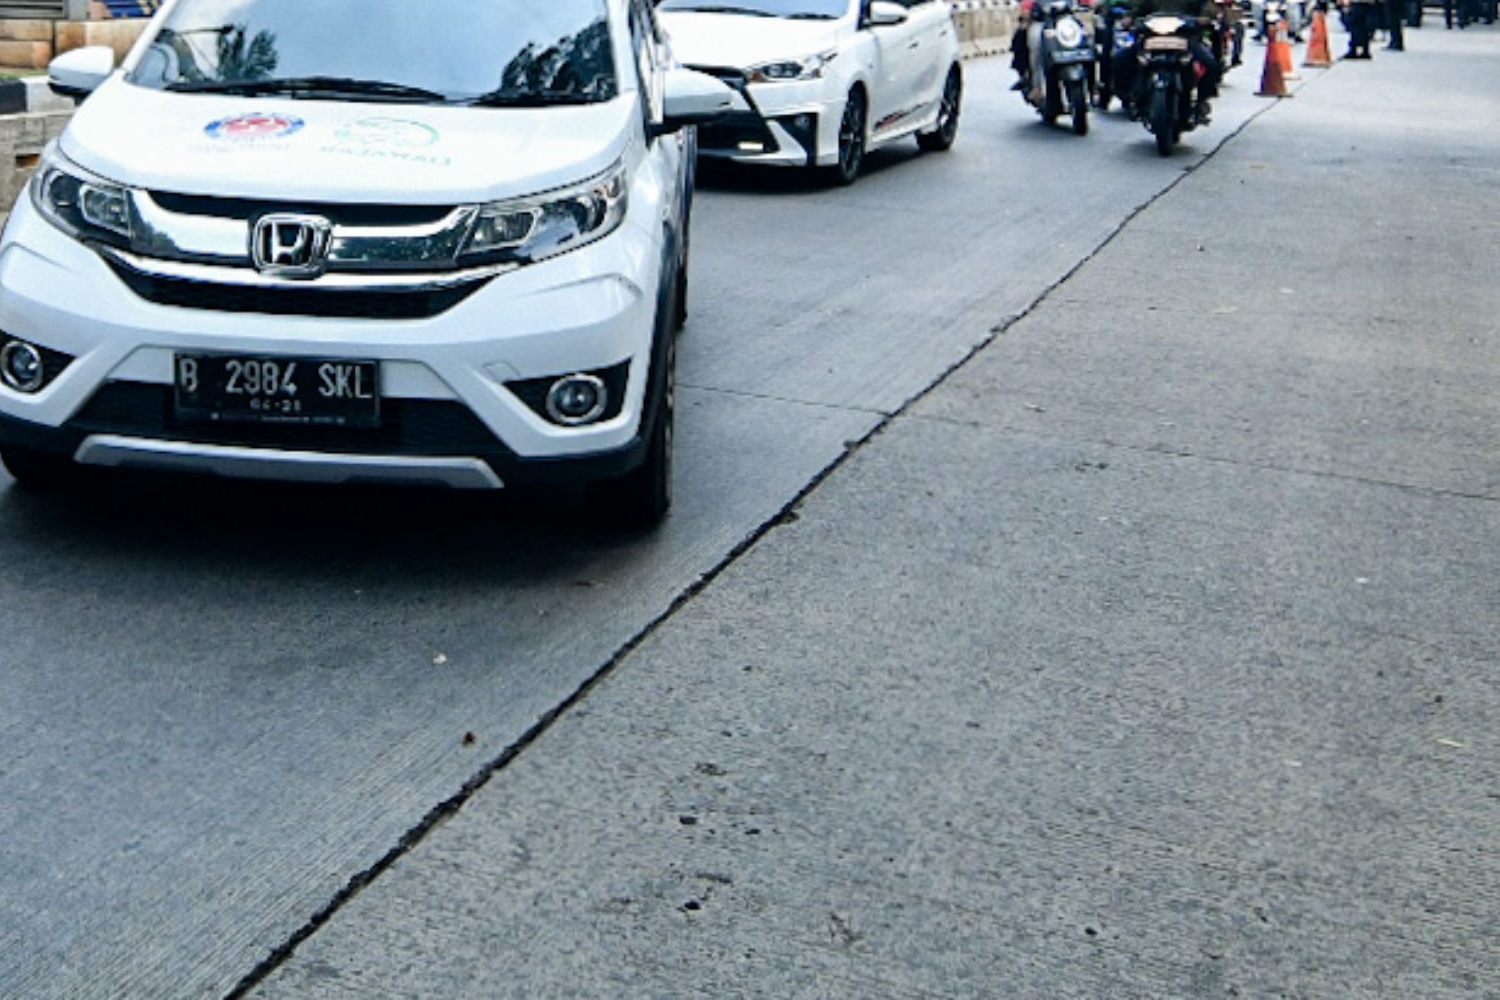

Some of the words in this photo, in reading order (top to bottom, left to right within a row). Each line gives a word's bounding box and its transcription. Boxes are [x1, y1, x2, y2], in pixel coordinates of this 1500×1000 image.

[178, 358, 199, 393] B
[224, 358, 298, 396] 2984
[317, 362, 374, 399] SKL
